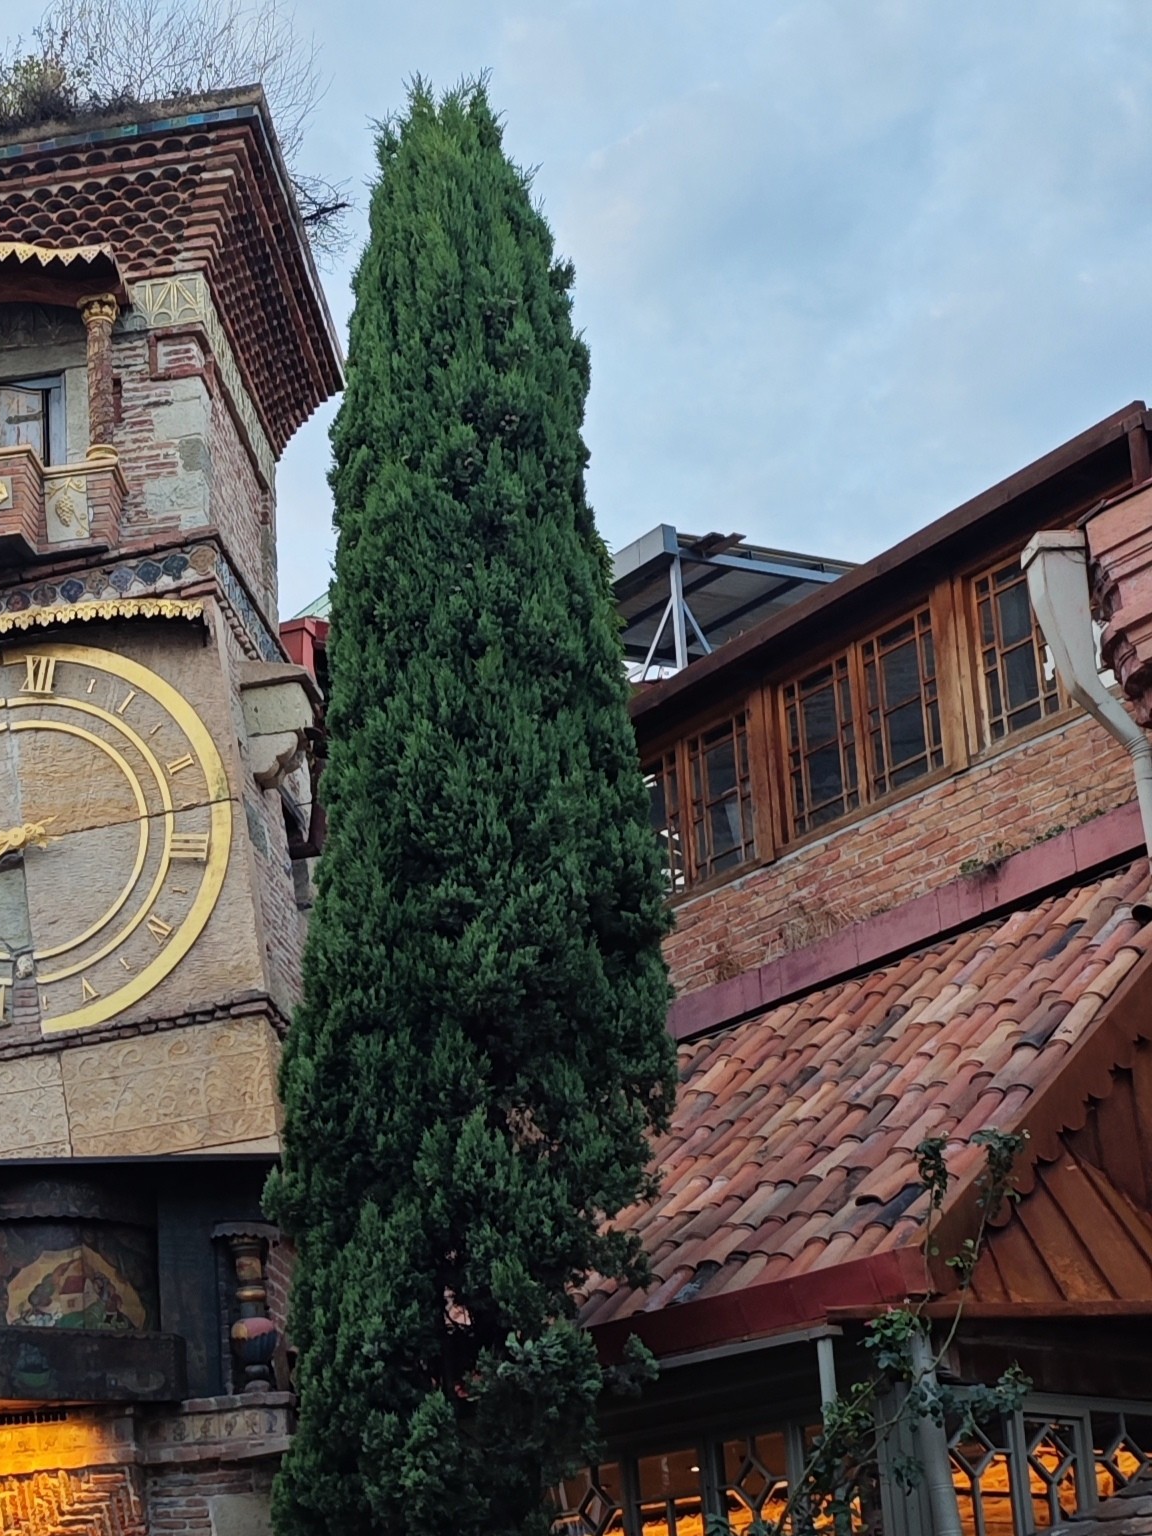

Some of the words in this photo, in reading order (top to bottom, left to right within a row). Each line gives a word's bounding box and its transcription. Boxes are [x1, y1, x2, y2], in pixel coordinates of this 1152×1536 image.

[19, 655, 56, 693] XII
[165, 752, 194, 775] II
[169, 831, 209, 861] III
[147, 914, 174, 945] IV
[81, 977, 100, 1004] V
